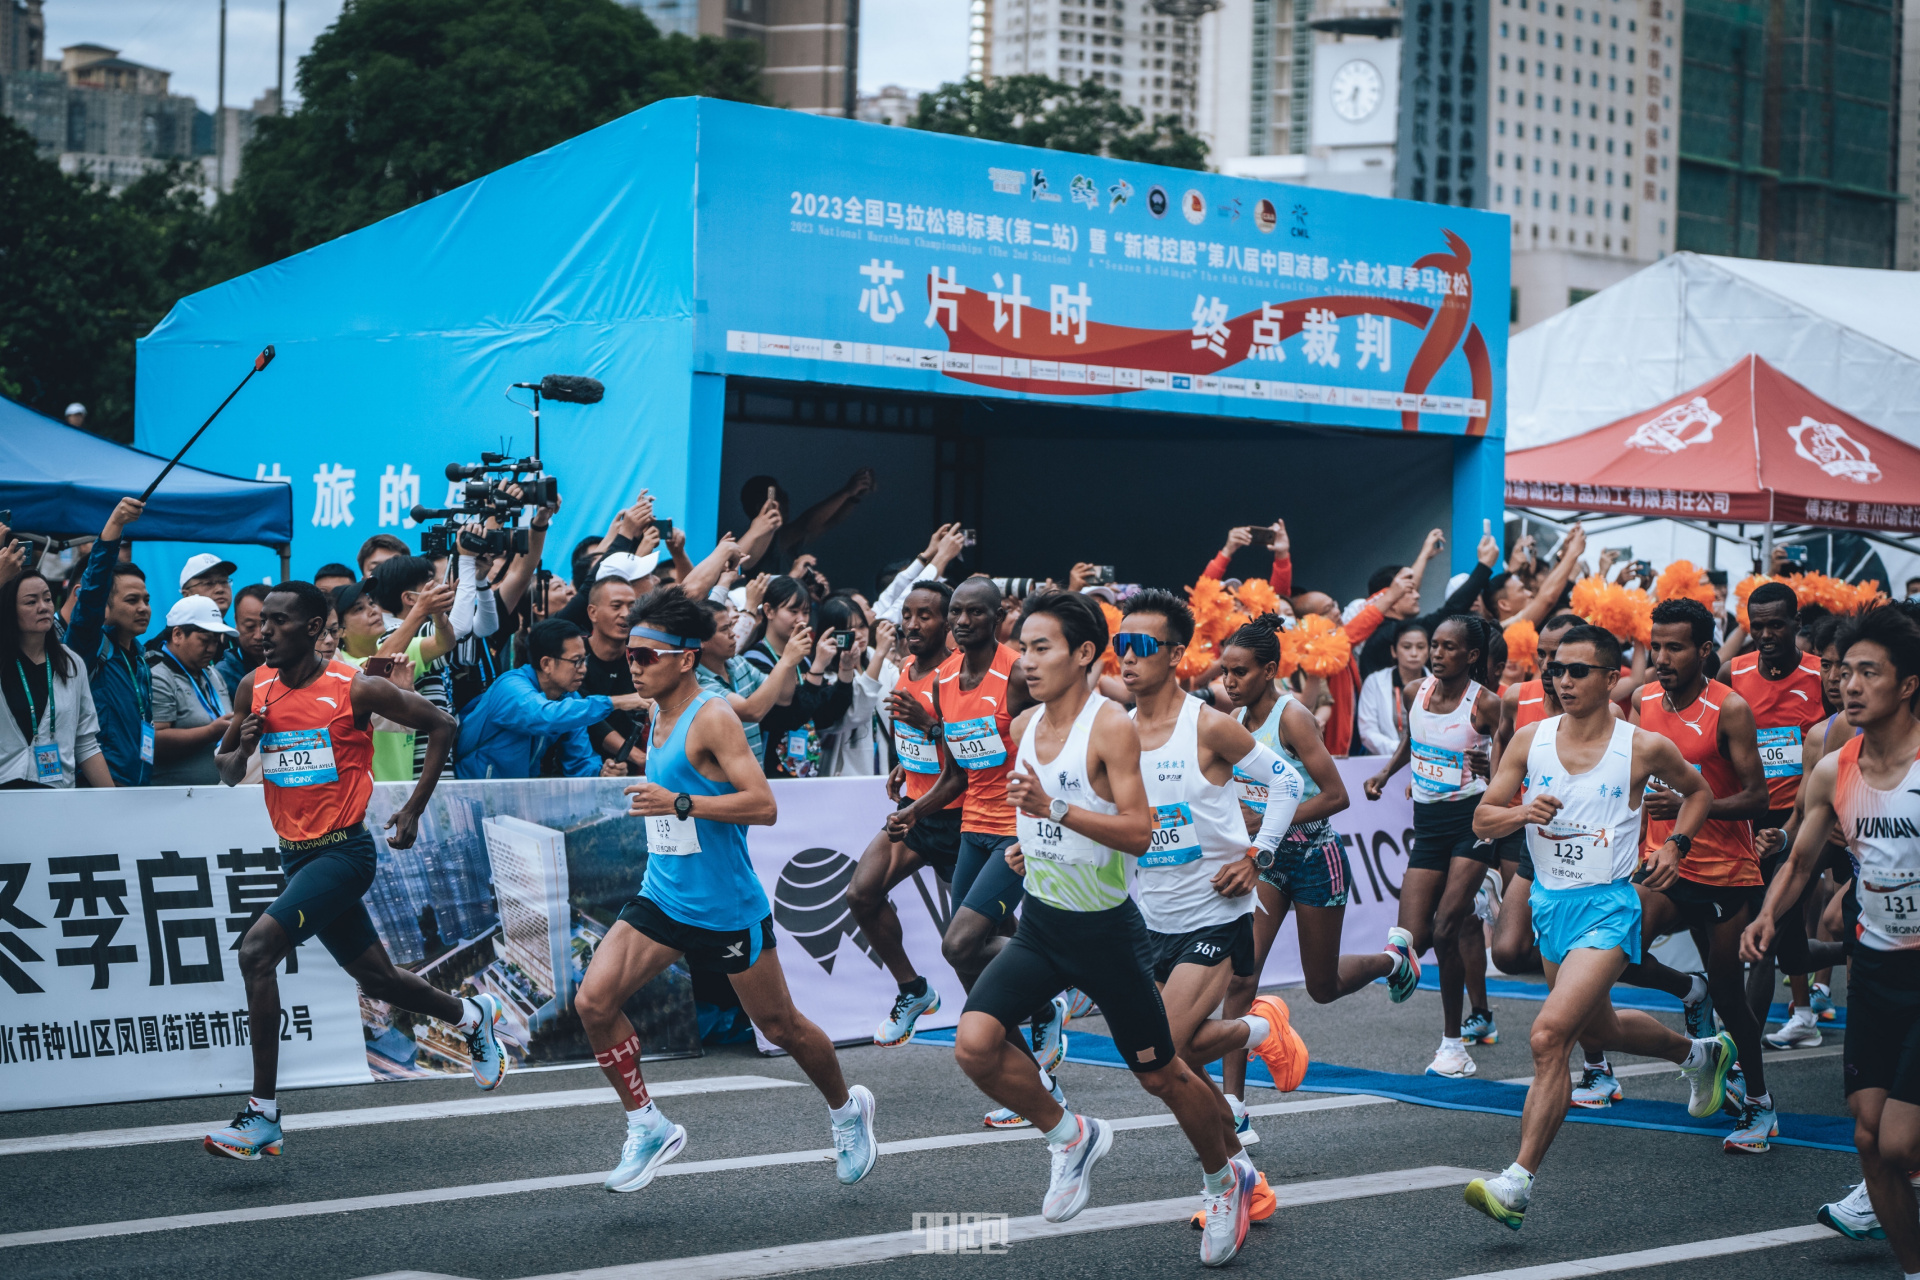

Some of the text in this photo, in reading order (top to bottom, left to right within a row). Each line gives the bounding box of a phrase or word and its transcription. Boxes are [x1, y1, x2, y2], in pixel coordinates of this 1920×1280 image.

[790, 191, 1079, 252] 2023全国马拉松锦标赛(第二站)
[1089, 228, 1107, 255] 暨
[790, 221, 814, 234] 2023
[818, 224, 863, 241] National
[867, 229, 911, 246] Marathon
[1290, 227, 1309, 239] CML
[858, 258, 1393, 373] 芯片计时 终点裁判
[901, 740, 920, 757] A-03
[960, 740, 986, 755] A-01
[279, 751, 312, 768] A-02
[1417, 761, 1443, 778] A-15
[1245, 784, 1268, 798] A-19
[1597, 783, 1623, 799] 青海
[1037, 821, 1063, 841] 104
[1856, 817, 1920, 839] YUNNAN
[301, 830, 348, 849] CHAMPION
[1554, 842, 1584, 861] 123
[1884, 896, 1918, 913] 131
